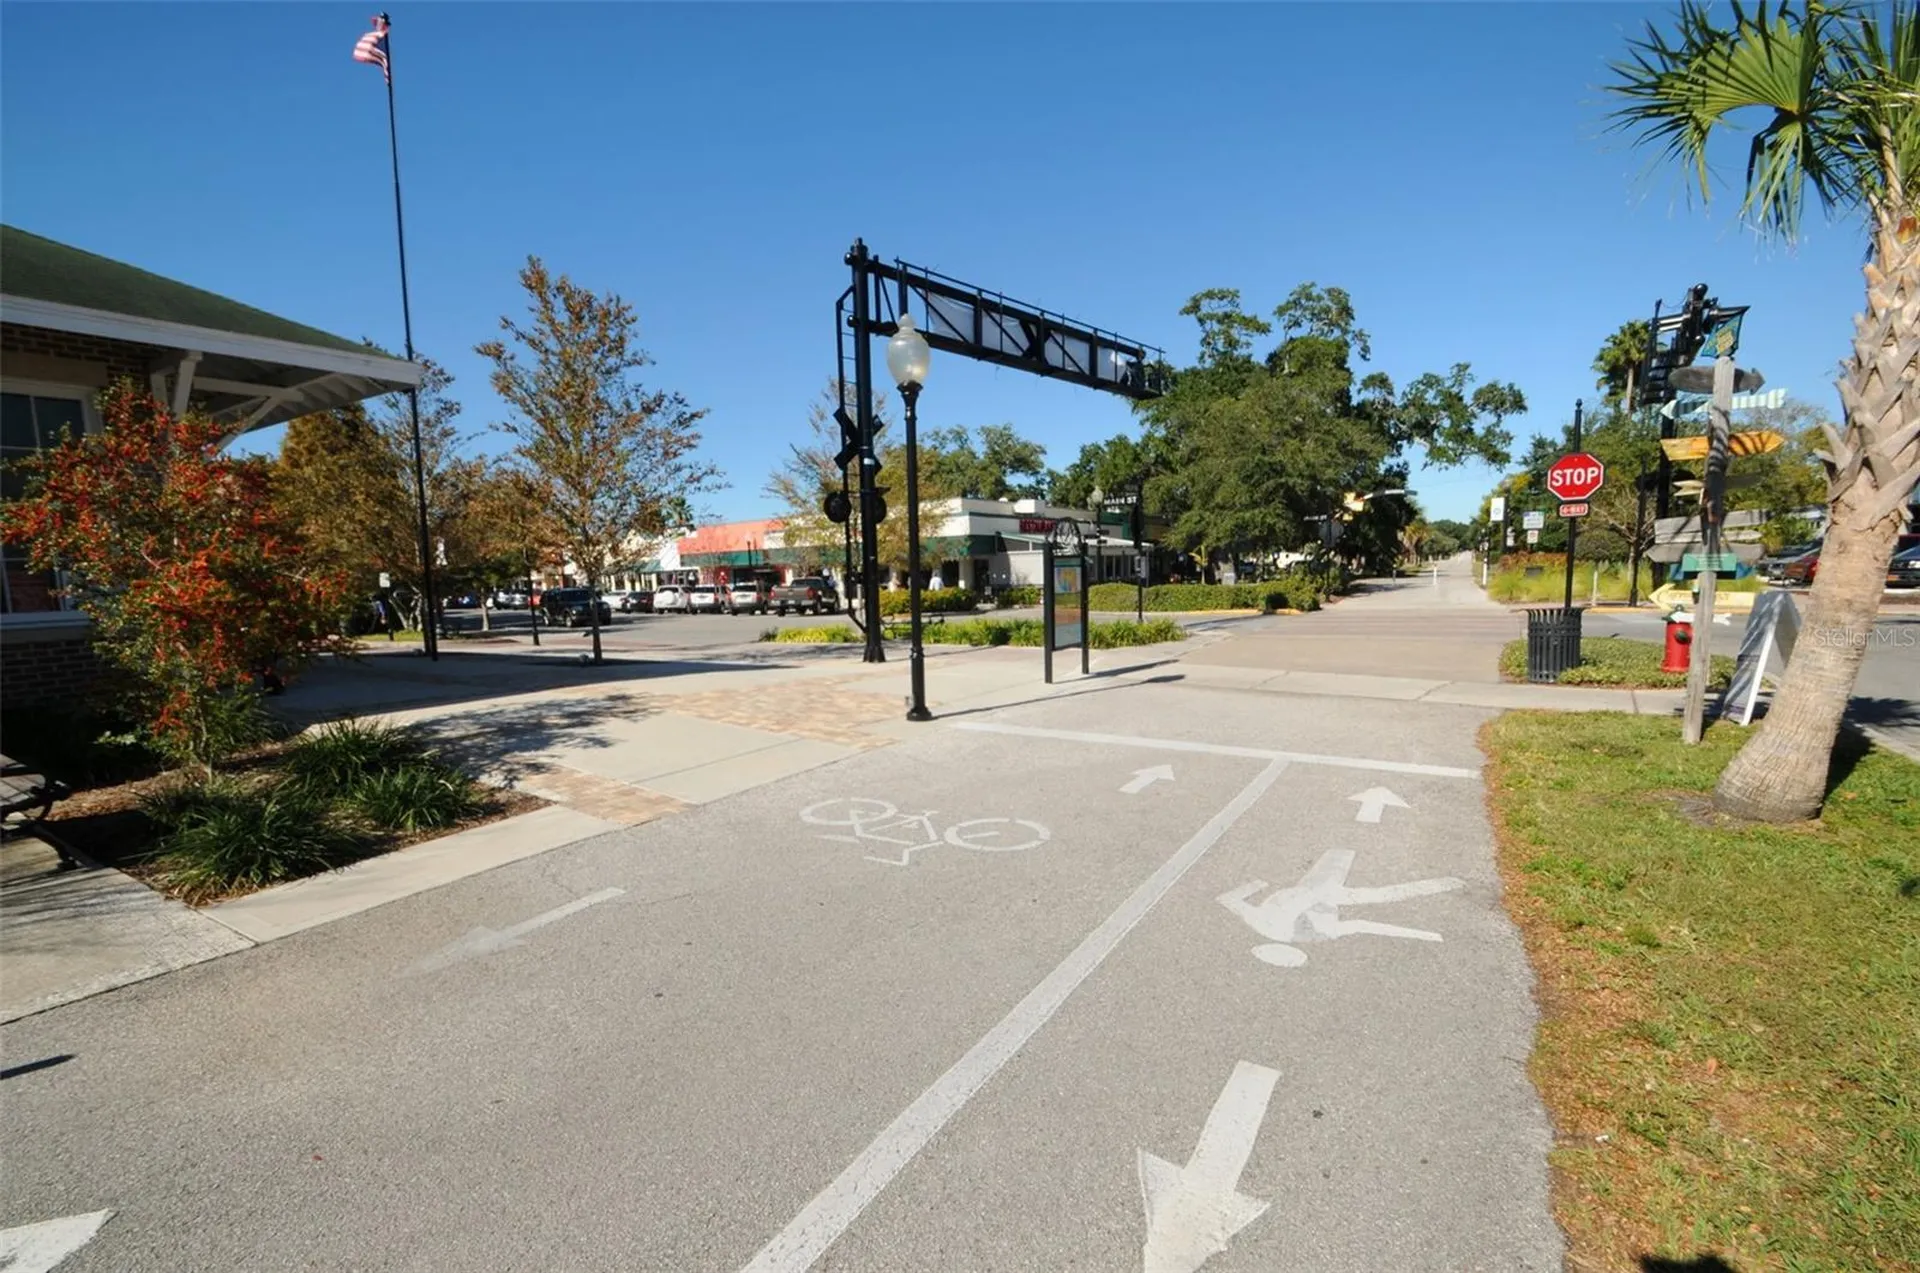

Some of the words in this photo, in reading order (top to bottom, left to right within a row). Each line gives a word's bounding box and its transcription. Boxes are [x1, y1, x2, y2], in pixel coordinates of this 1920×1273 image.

[1552, 467, 1599, 487] STOP
[1103, 497, 1125, 505] MAIN
[1126, 496, 1137, 504] ST
